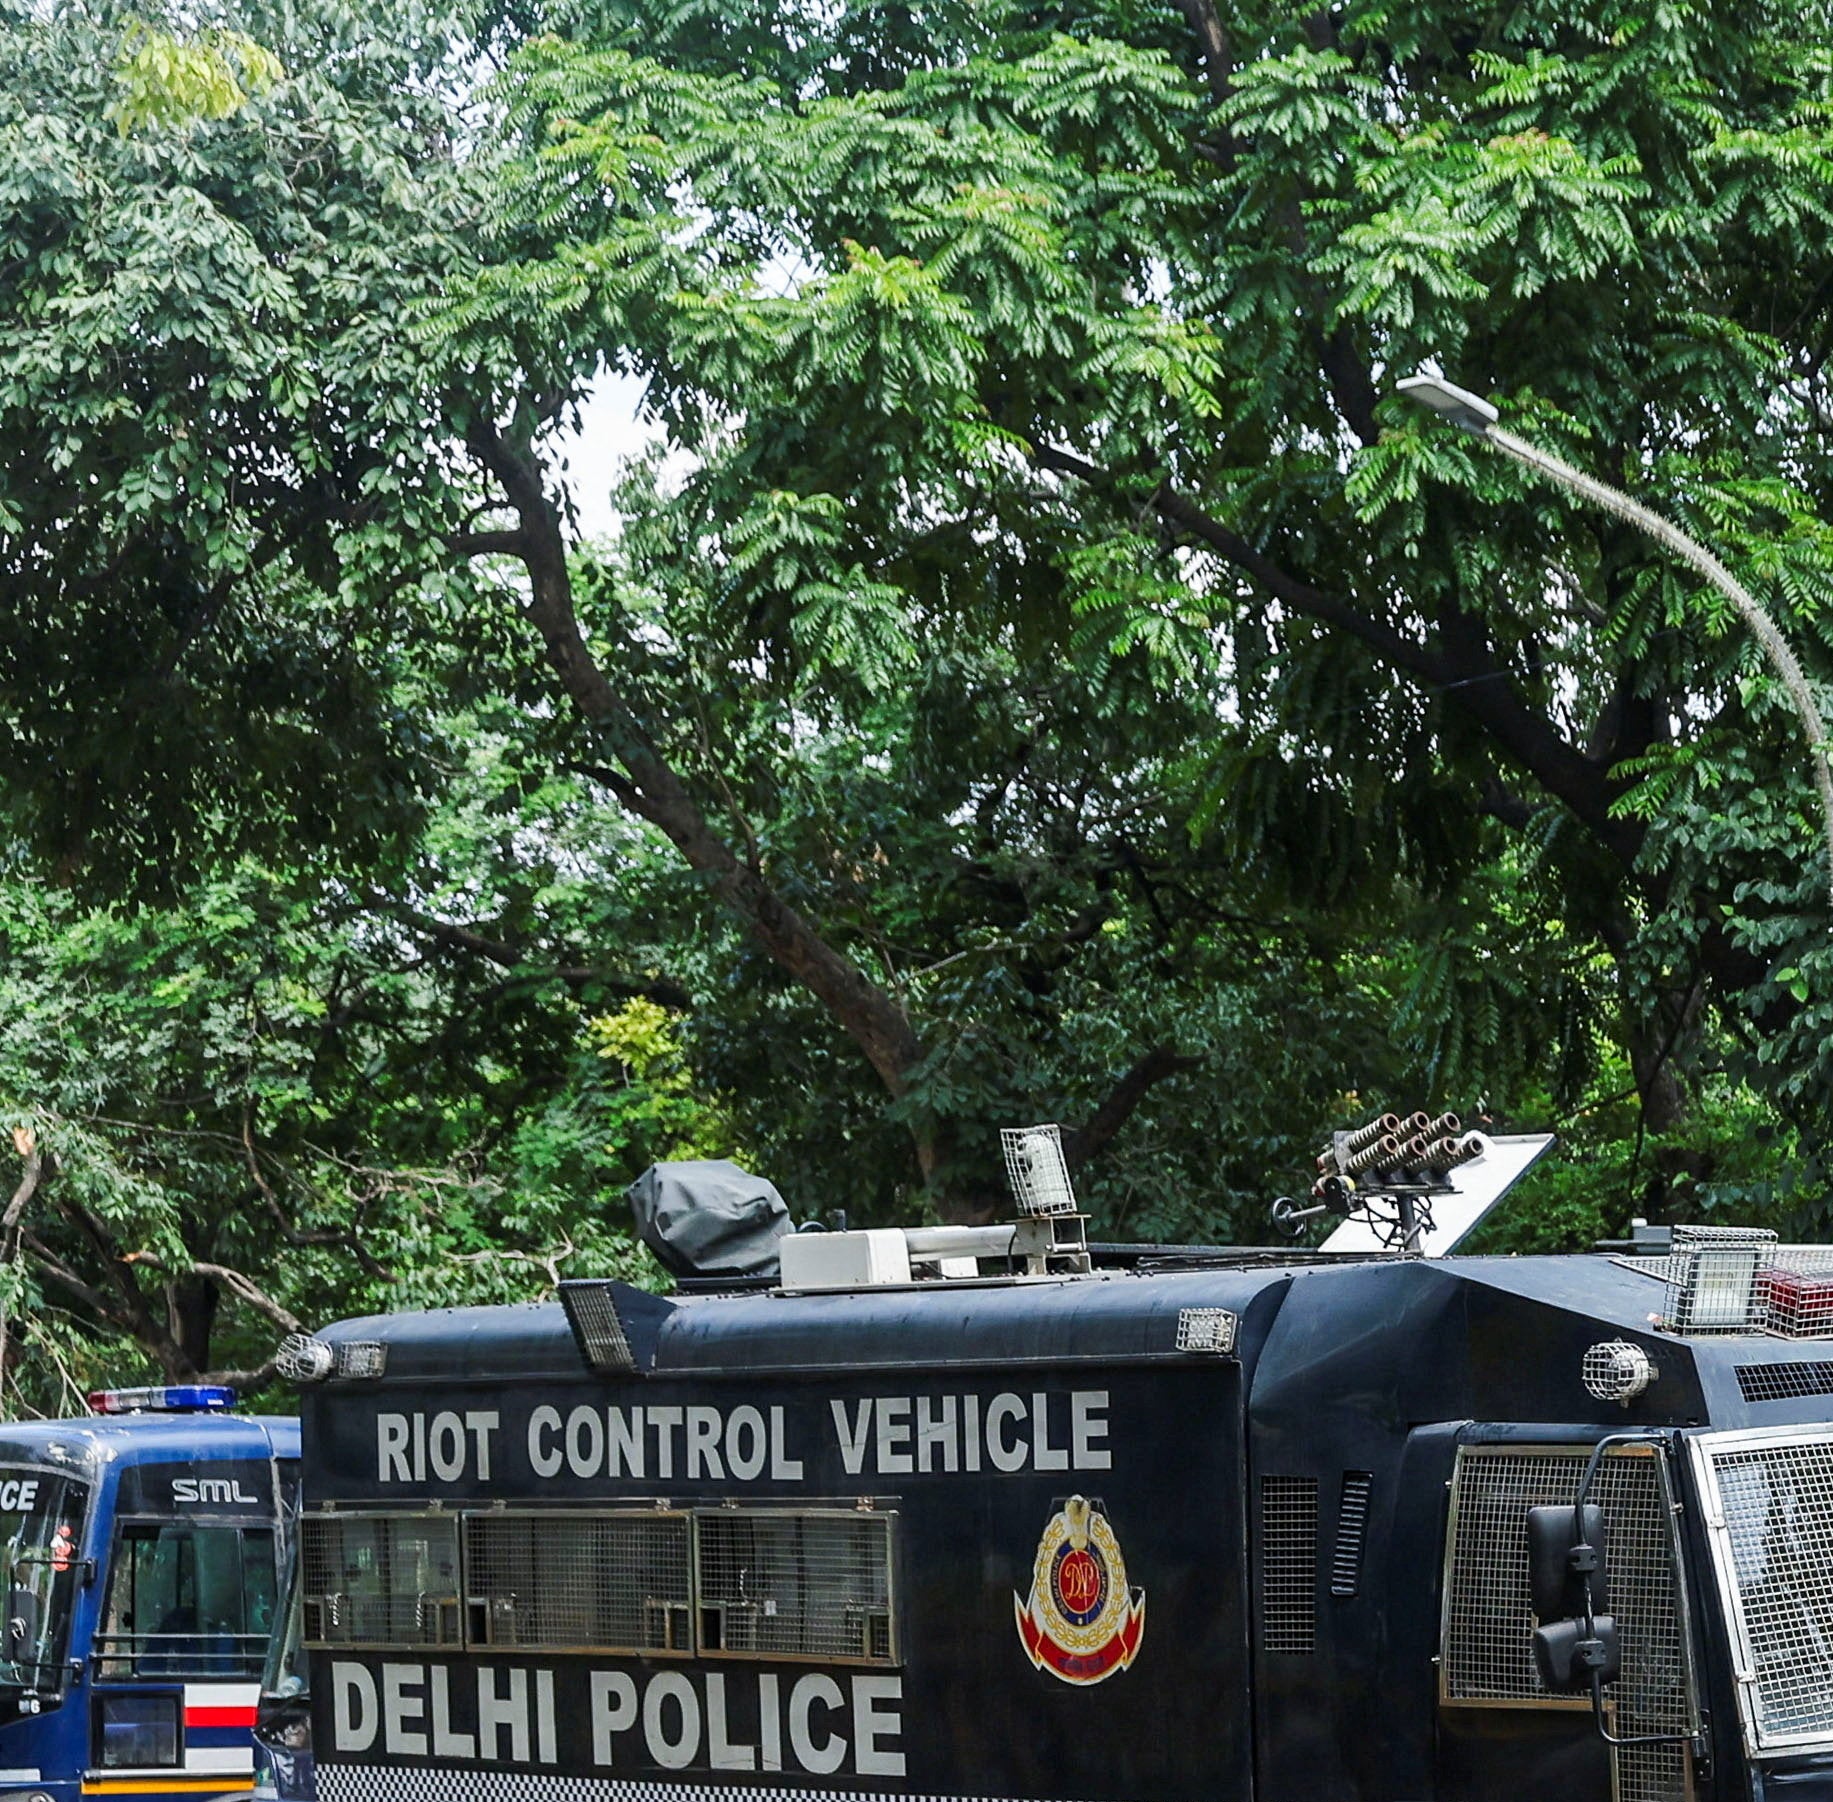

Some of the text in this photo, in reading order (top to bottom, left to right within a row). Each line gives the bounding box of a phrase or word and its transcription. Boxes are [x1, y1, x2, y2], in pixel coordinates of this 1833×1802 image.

[377, 1391, 1112, 1482] RIOT CONTROL VEHICLE
[172, 1479, 258, 1503] SML
[331, 1661, 906, 1777] DELHI POLICE
